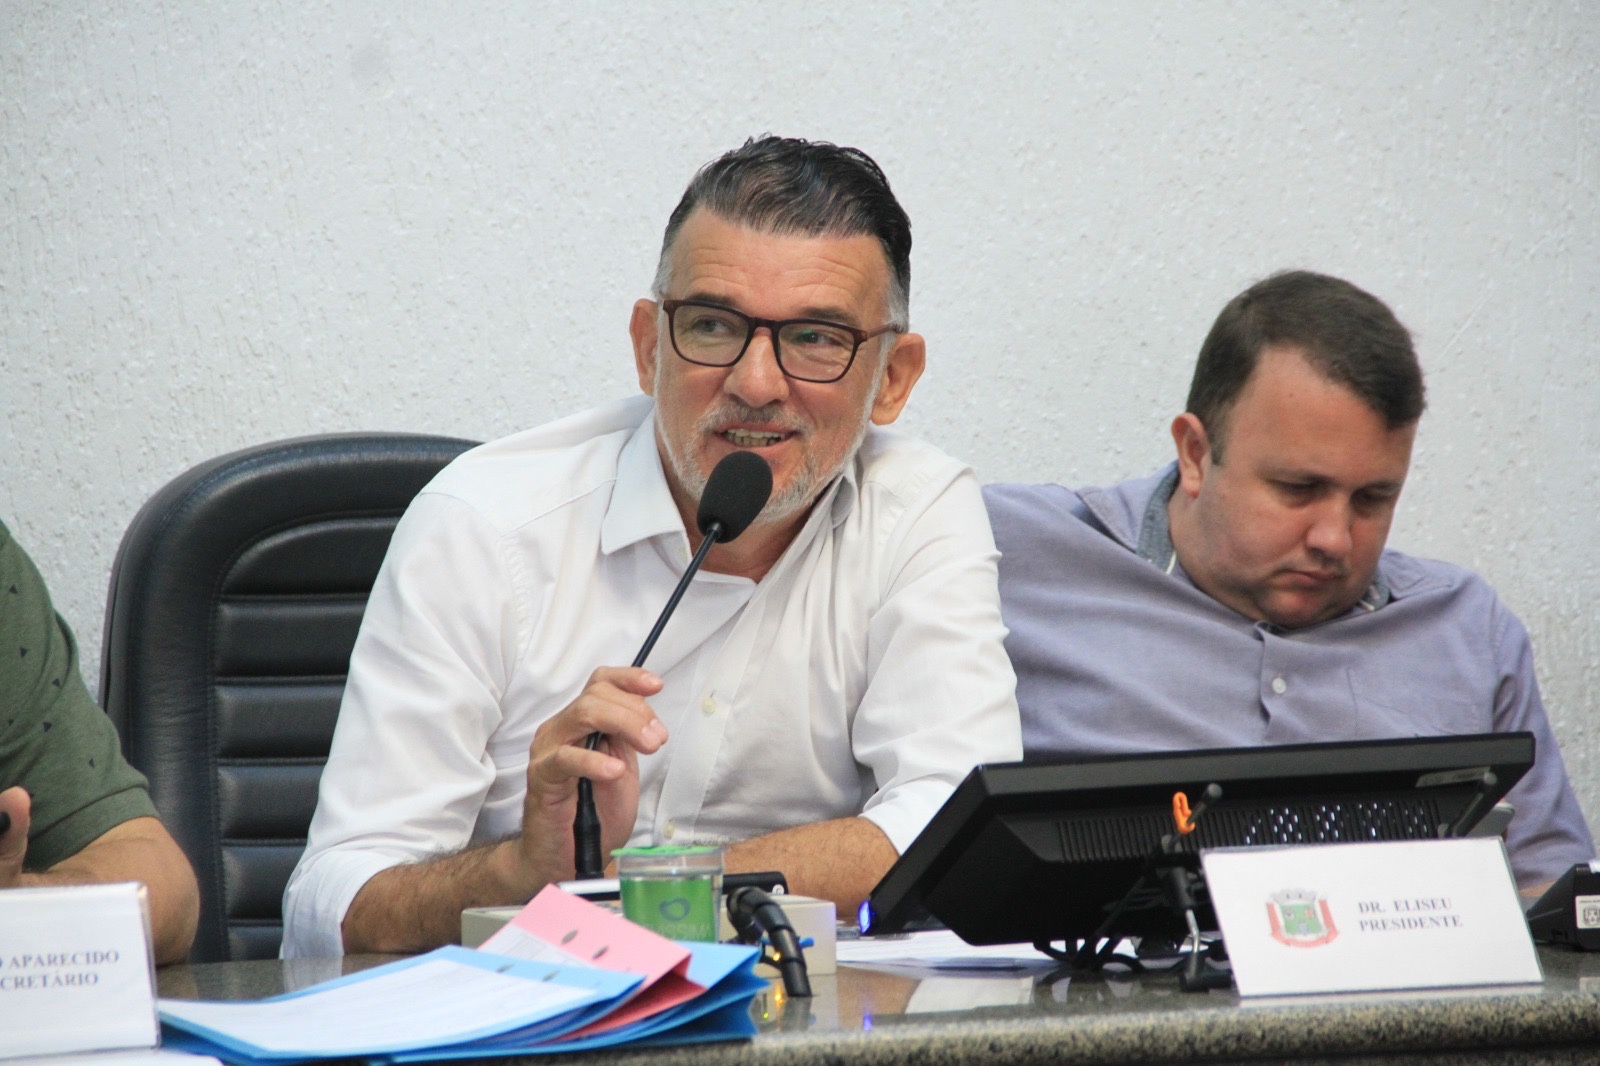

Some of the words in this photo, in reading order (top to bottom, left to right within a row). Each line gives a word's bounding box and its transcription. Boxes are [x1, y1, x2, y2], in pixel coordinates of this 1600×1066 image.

[1357, 901, 1386, 915] DR.
[1393, 898, 1452, 913] ELISEU
[1359, 915, 1463, 932] PRESIDENTE
[9, 950, 119, 968] APARECIDO
